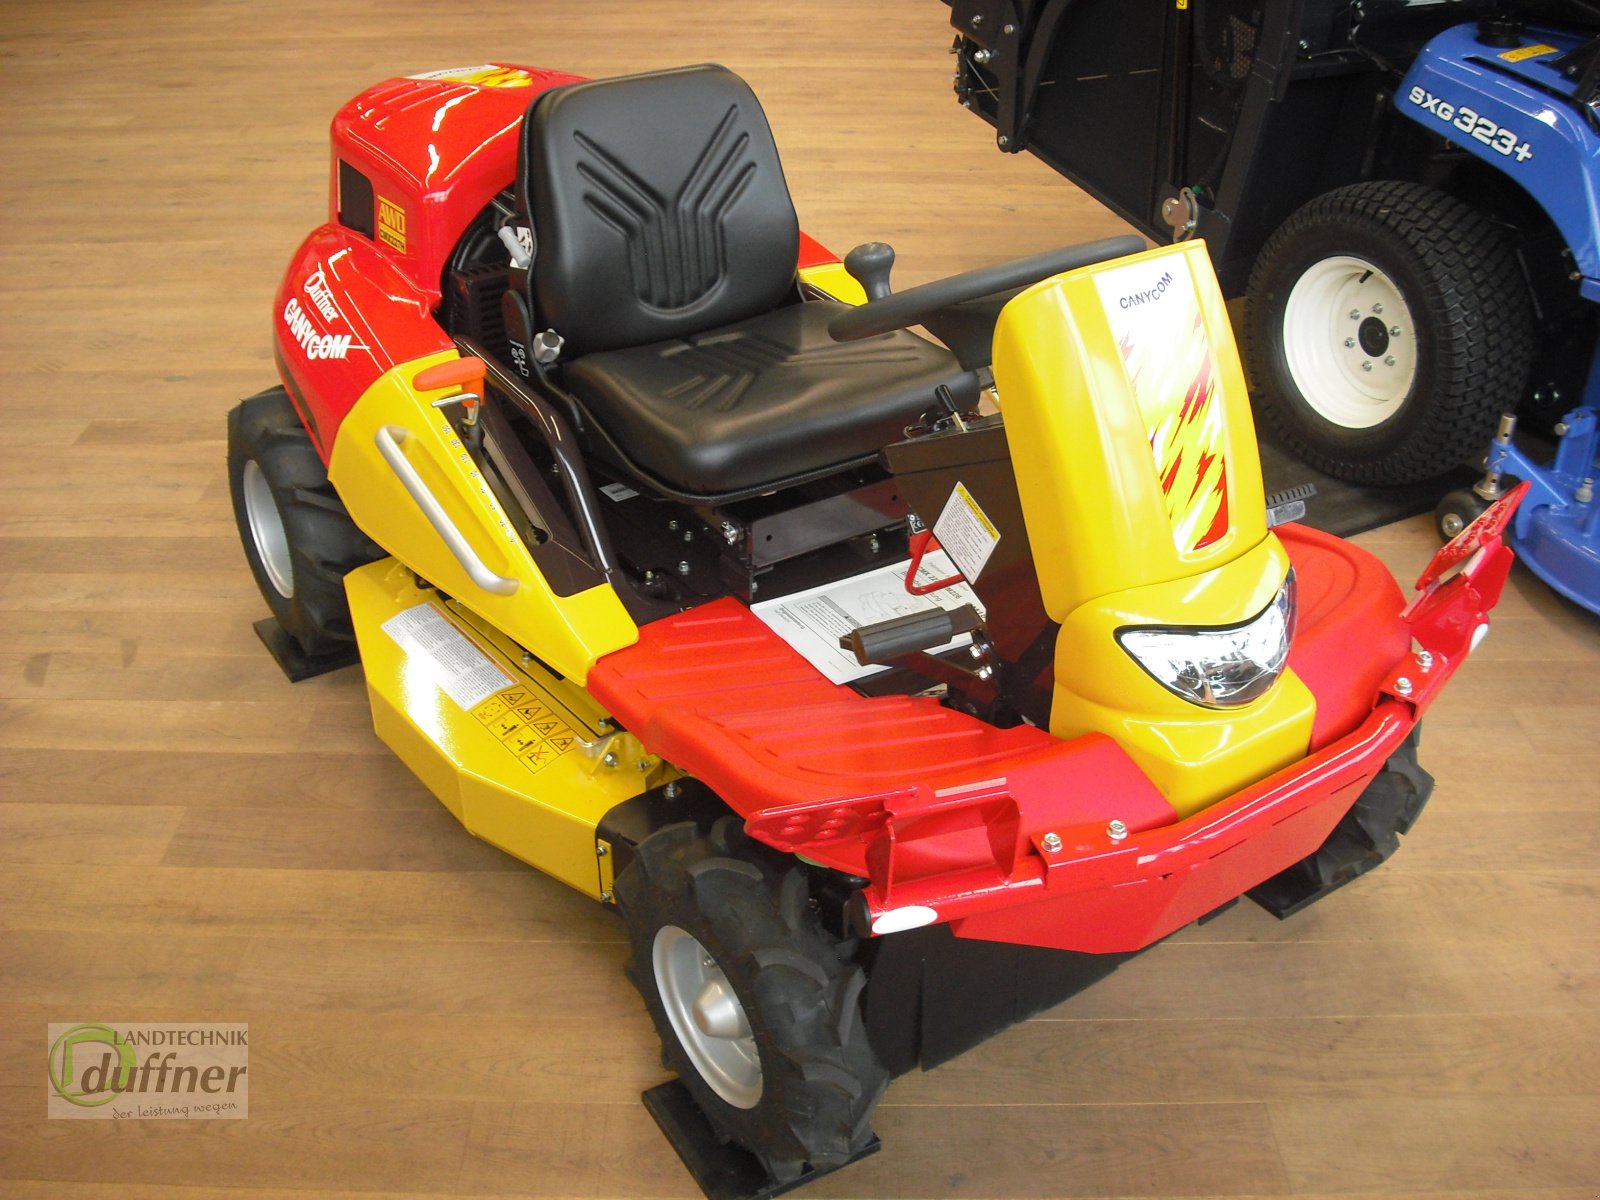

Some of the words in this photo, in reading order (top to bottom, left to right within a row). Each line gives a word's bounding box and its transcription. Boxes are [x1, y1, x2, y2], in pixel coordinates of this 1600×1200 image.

[1409, 86, 1455, 121] SXG
[1453, 107, 1533, 162] 323+
[379, 202, 405, 235] AWD
[1120, 272, 1173, 309] CANYCOM
[284, 298, 352, 360] CANYCOM
